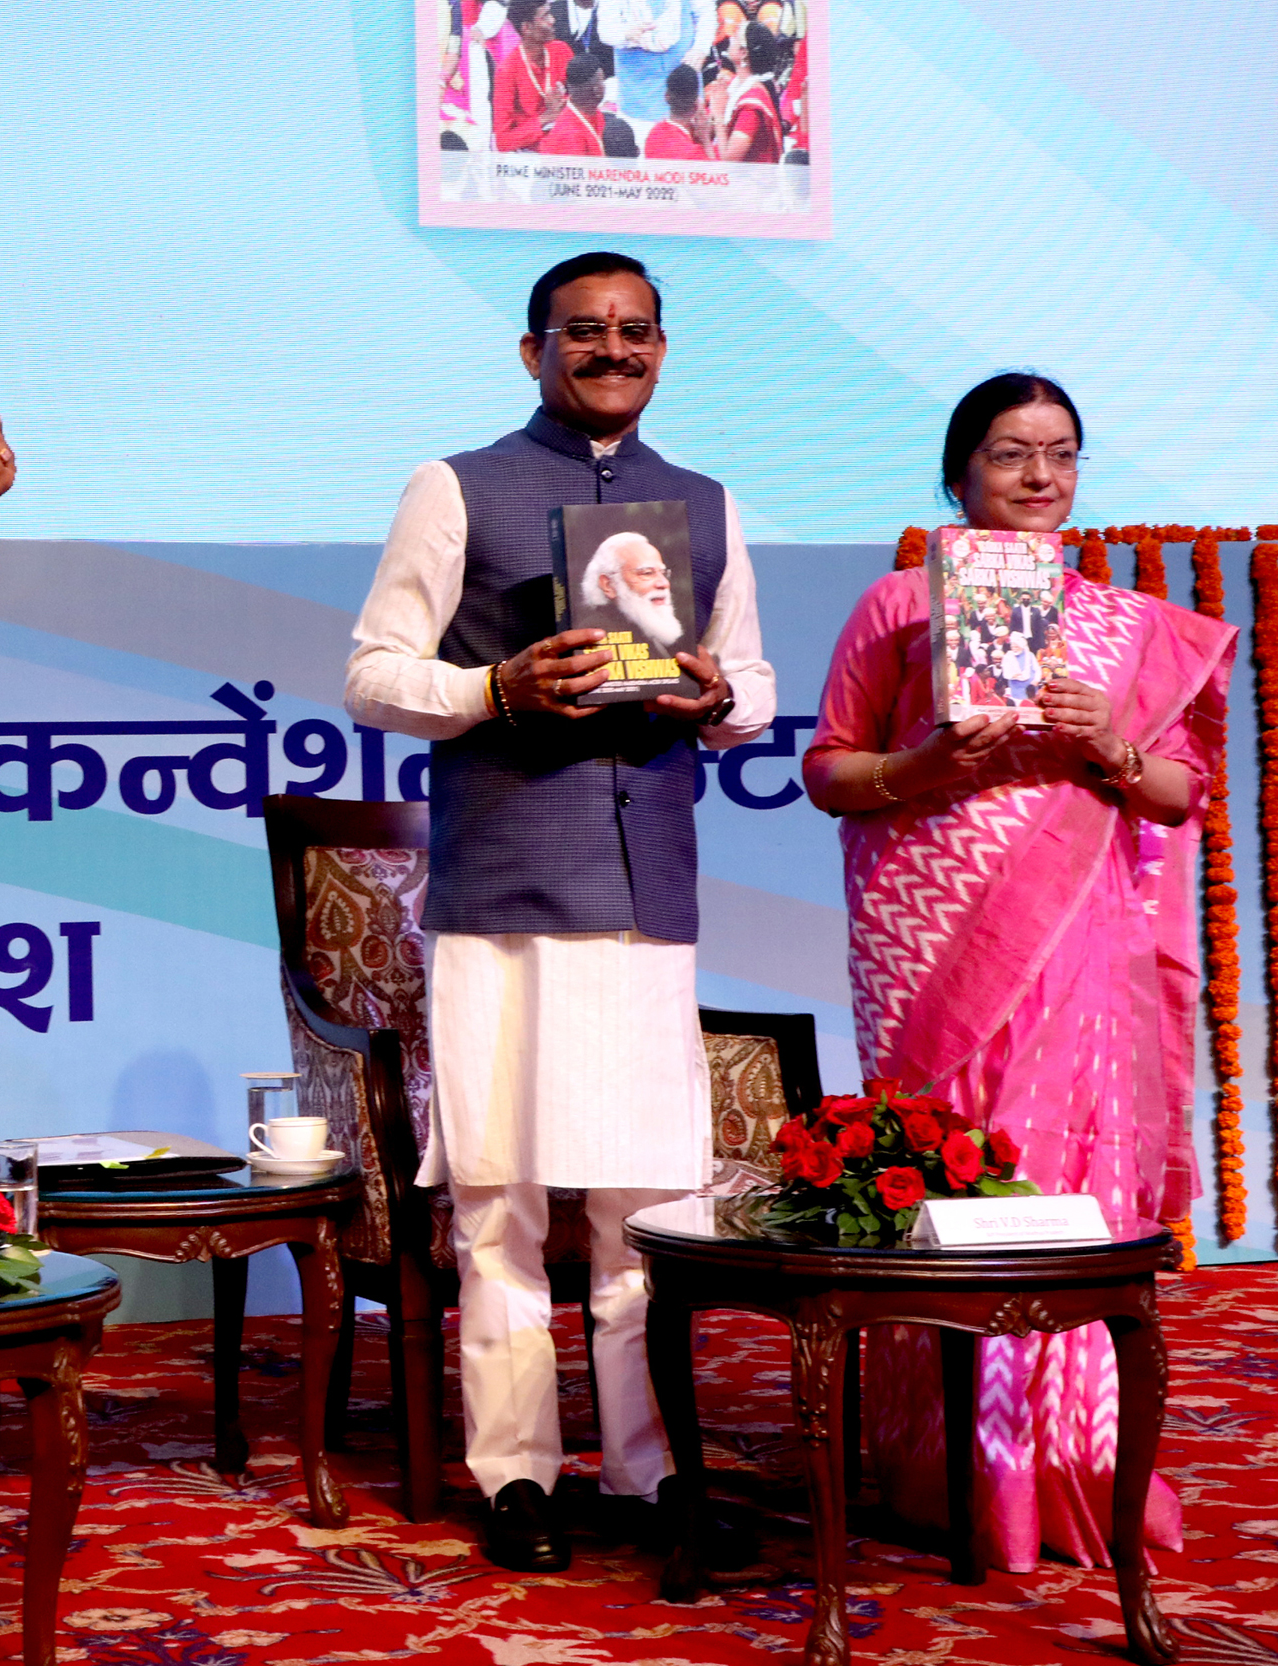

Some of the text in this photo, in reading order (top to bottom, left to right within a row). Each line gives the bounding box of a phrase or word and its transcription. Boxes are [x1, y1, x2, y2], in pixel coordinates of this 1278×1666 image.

[496, 164, 730, 186] PRIME MINISTER NARENDRA MODI SPEAKS
[549, 182, 582, 199] (JUNE
[646, 186, 679, 202] 2022)
[959, 567, 1052, 590] SABKA VISHWAS
[973, 1217, 999, 1229] Shri
[1023, 1215, 1070, 1228] Sharma
